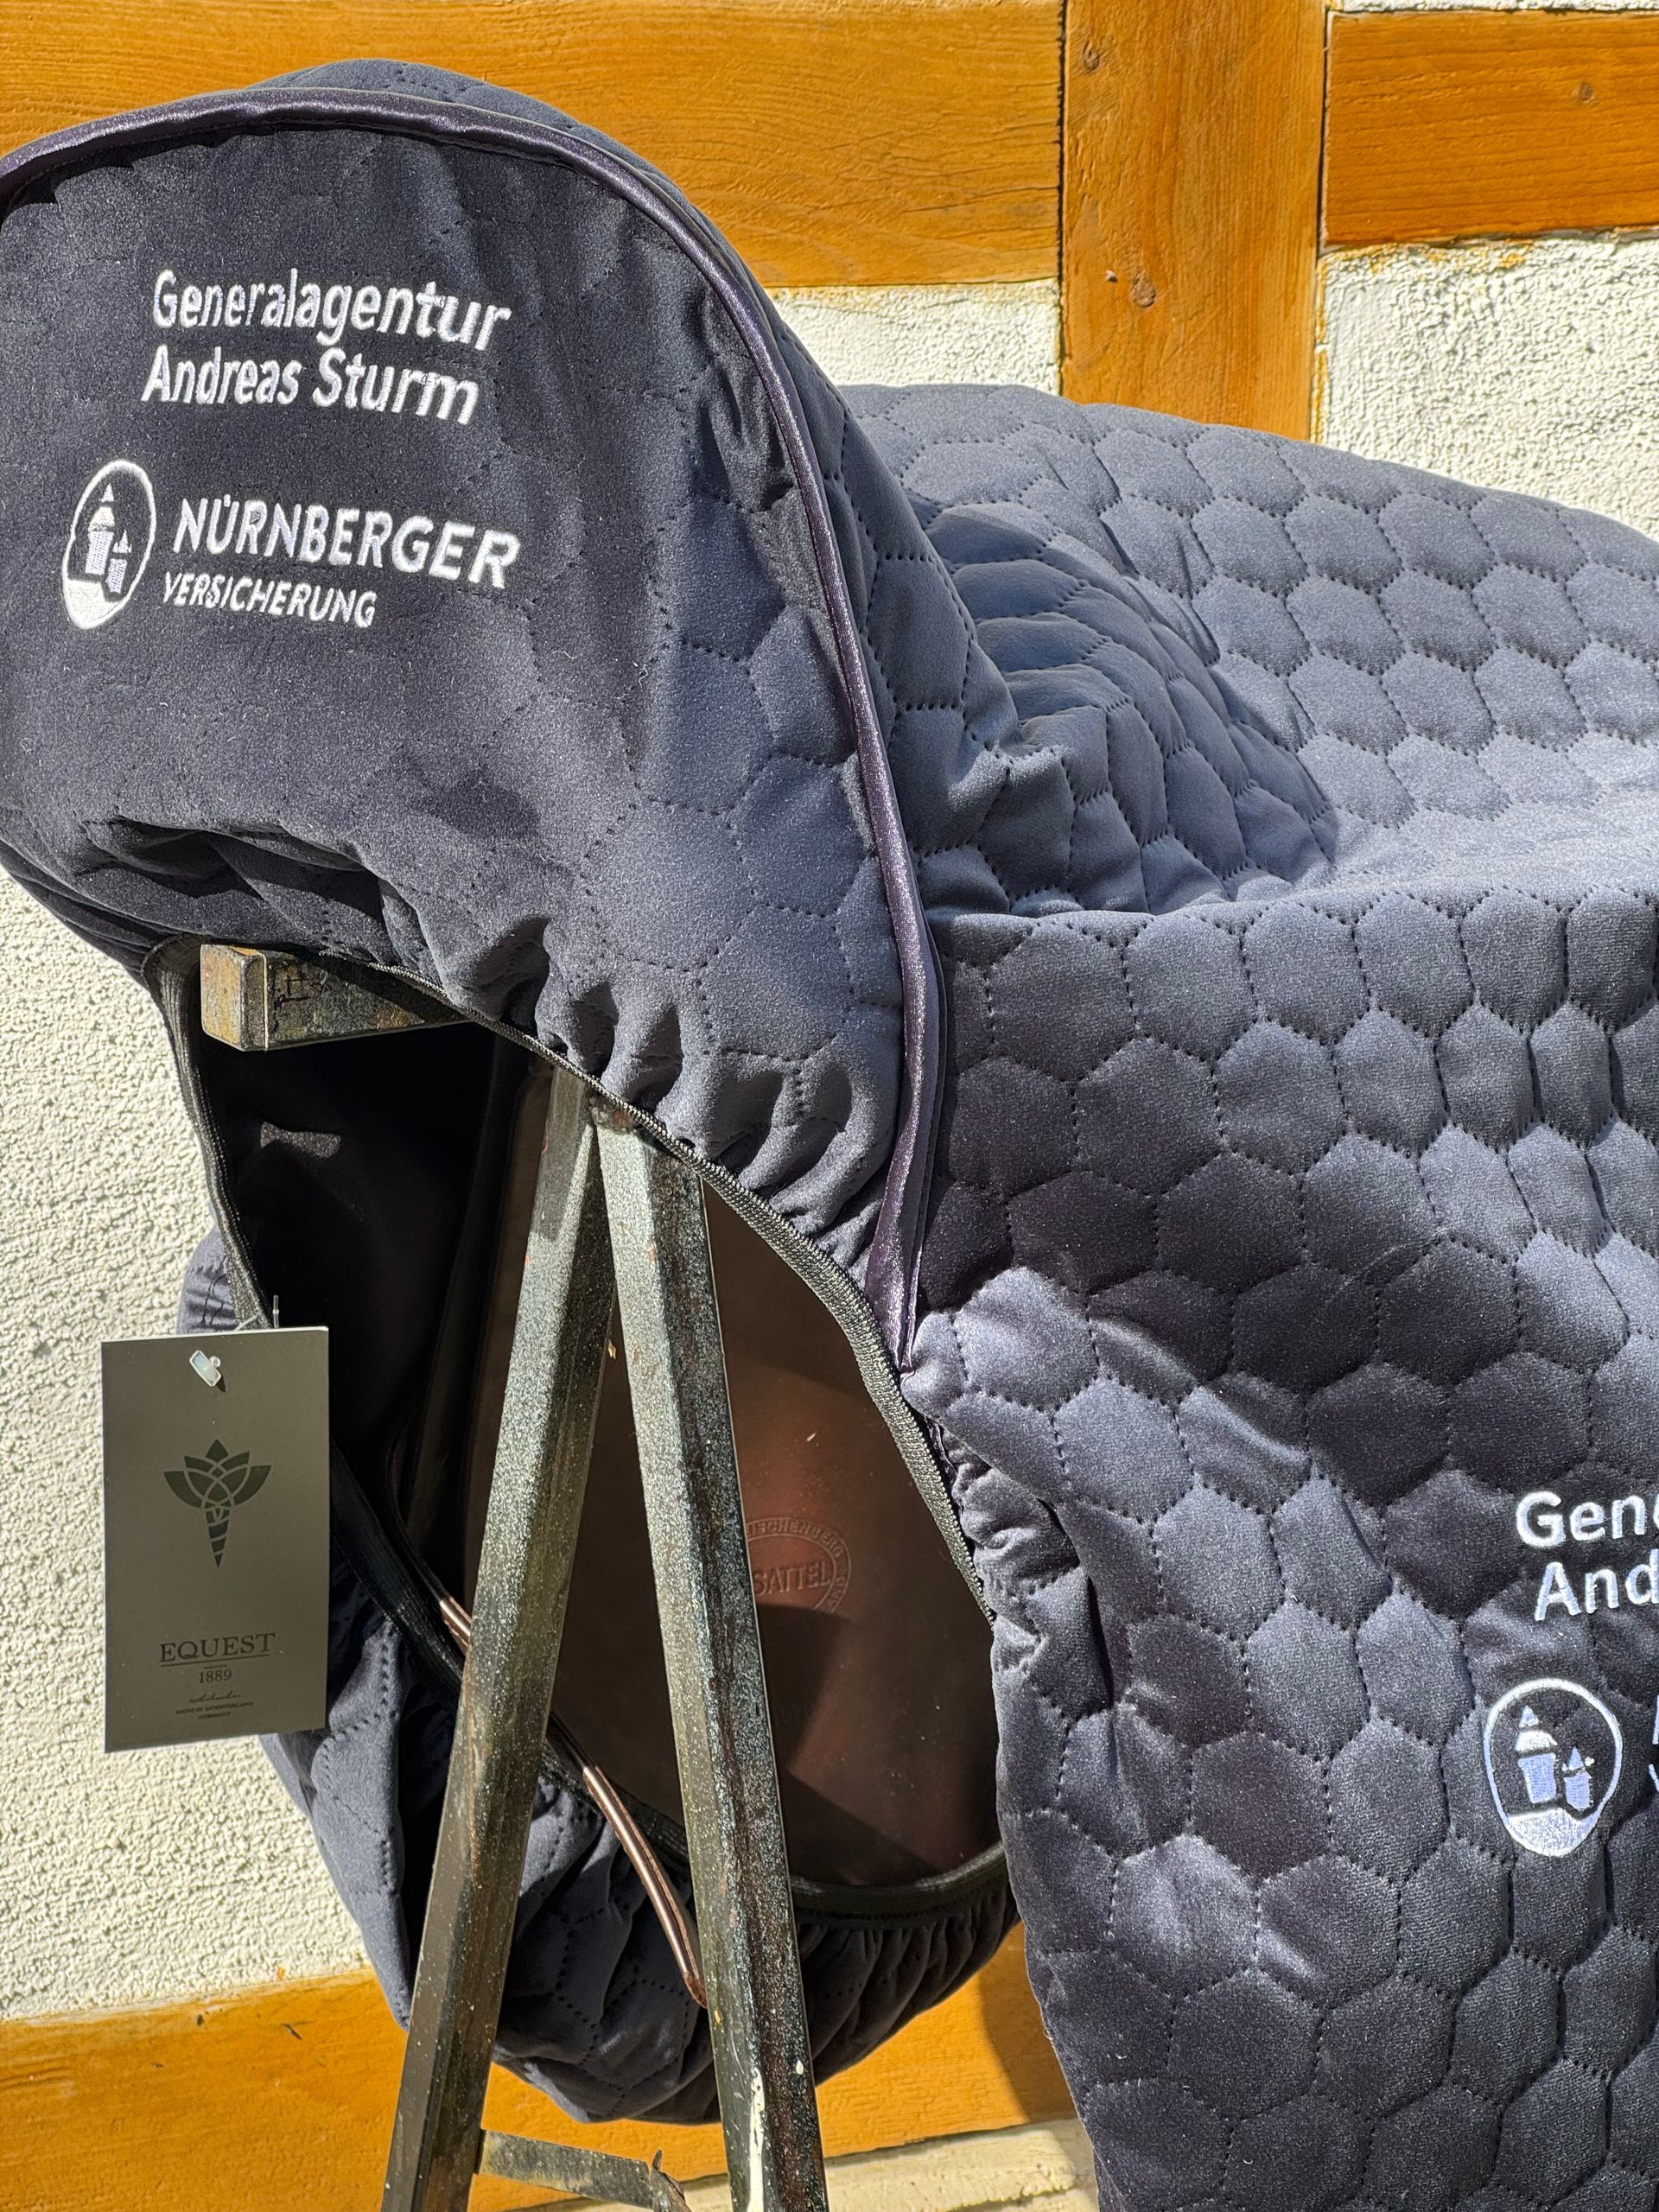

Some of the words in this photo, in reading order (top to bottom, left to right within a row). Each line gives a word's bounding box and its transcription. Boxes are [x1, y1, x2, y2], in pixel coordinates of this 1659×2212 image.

[152, 267, 512, 351] Generalagentur
[141, 344, 302, 405] Andreas
[312, 346, 480, 425] Sturm
[173, 493, 521, 589] NÜRNBERGER
[163, 570, 378, 628] VERSICHERUNG
[1516, 1491, 1659, 1548] Gen
[159, 1632, 276, 1662] EQUEST
[199, 1669, 232, 1684] 1889
